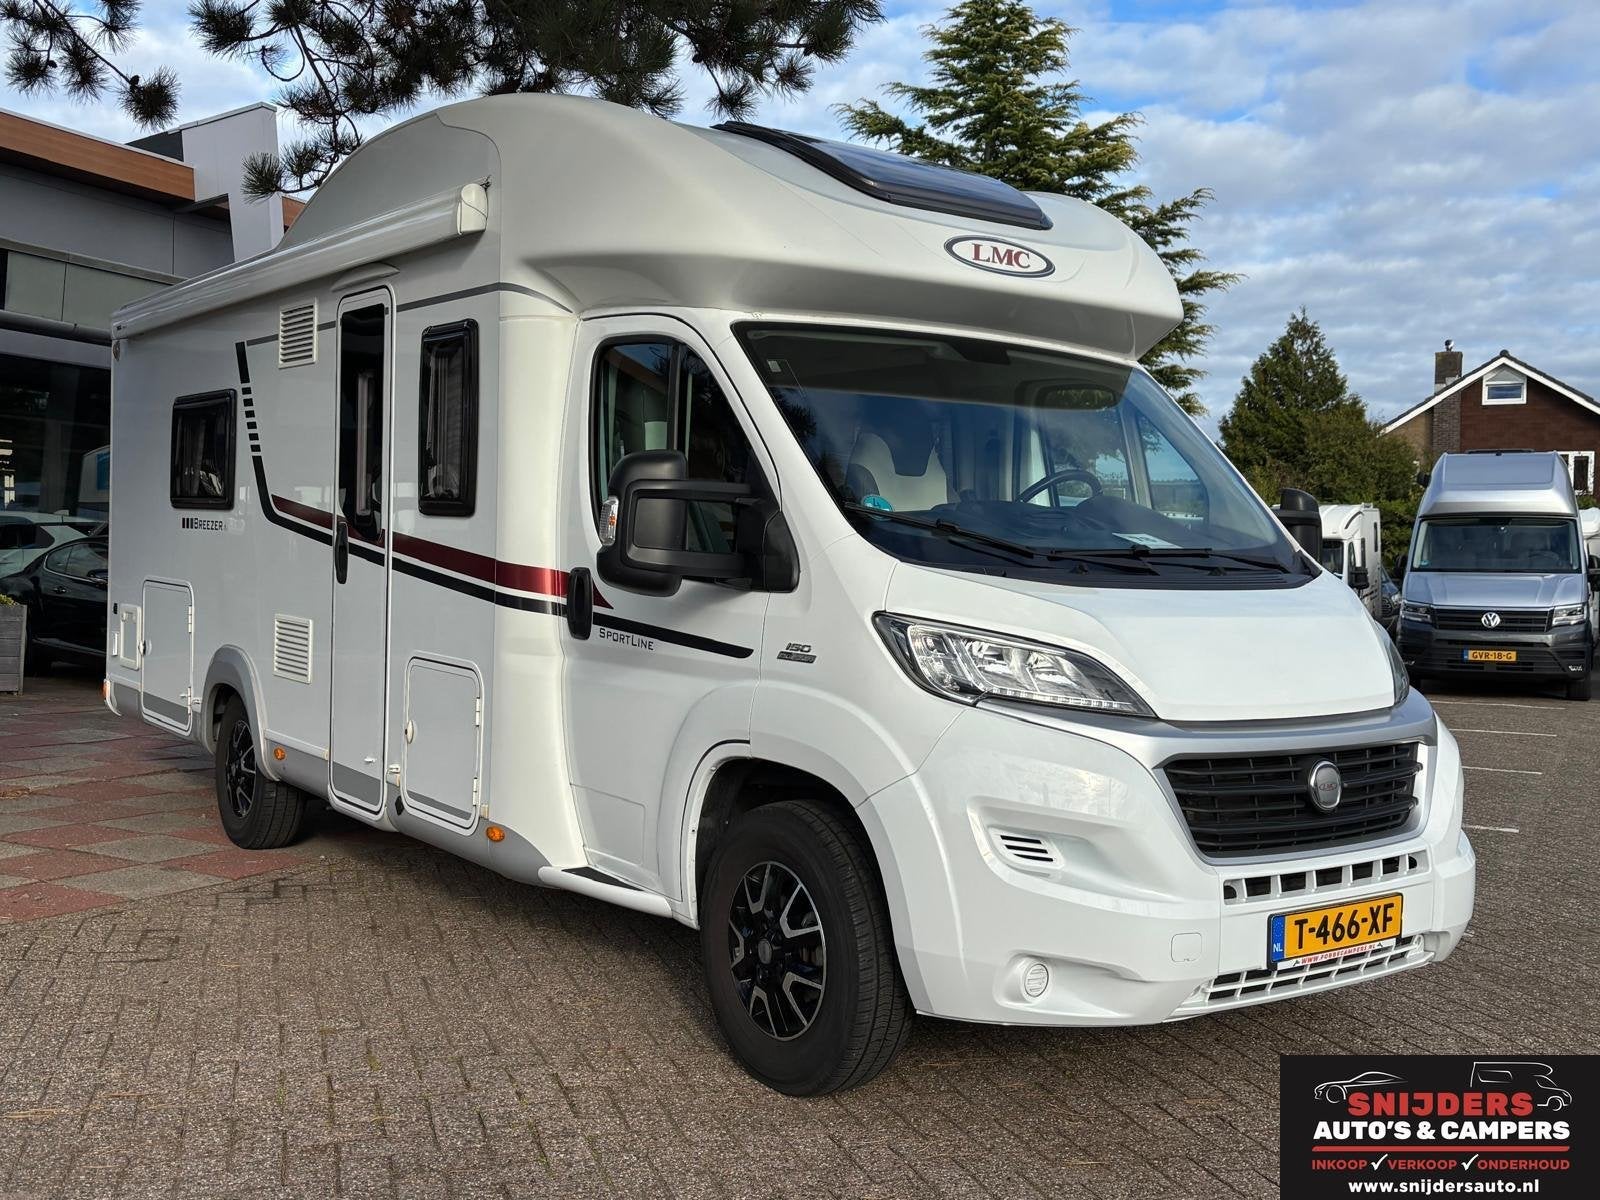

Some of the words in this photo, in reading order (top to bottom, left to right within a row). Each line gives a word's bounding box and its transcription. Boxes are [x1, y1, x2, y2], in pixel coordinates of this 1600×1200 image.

[971, 242, 1031, 269] LMC
[194, 517, 223, 531] BREEZER
[599, 627, 654, 651] SPORTLINE
[785, 642, 812, 653] 150
[1471, 651, 1512, 660] GVR-18-G
[1273, 943, 1283, 953] NL
[1294, 902, 1395, 950] T-466-XF
